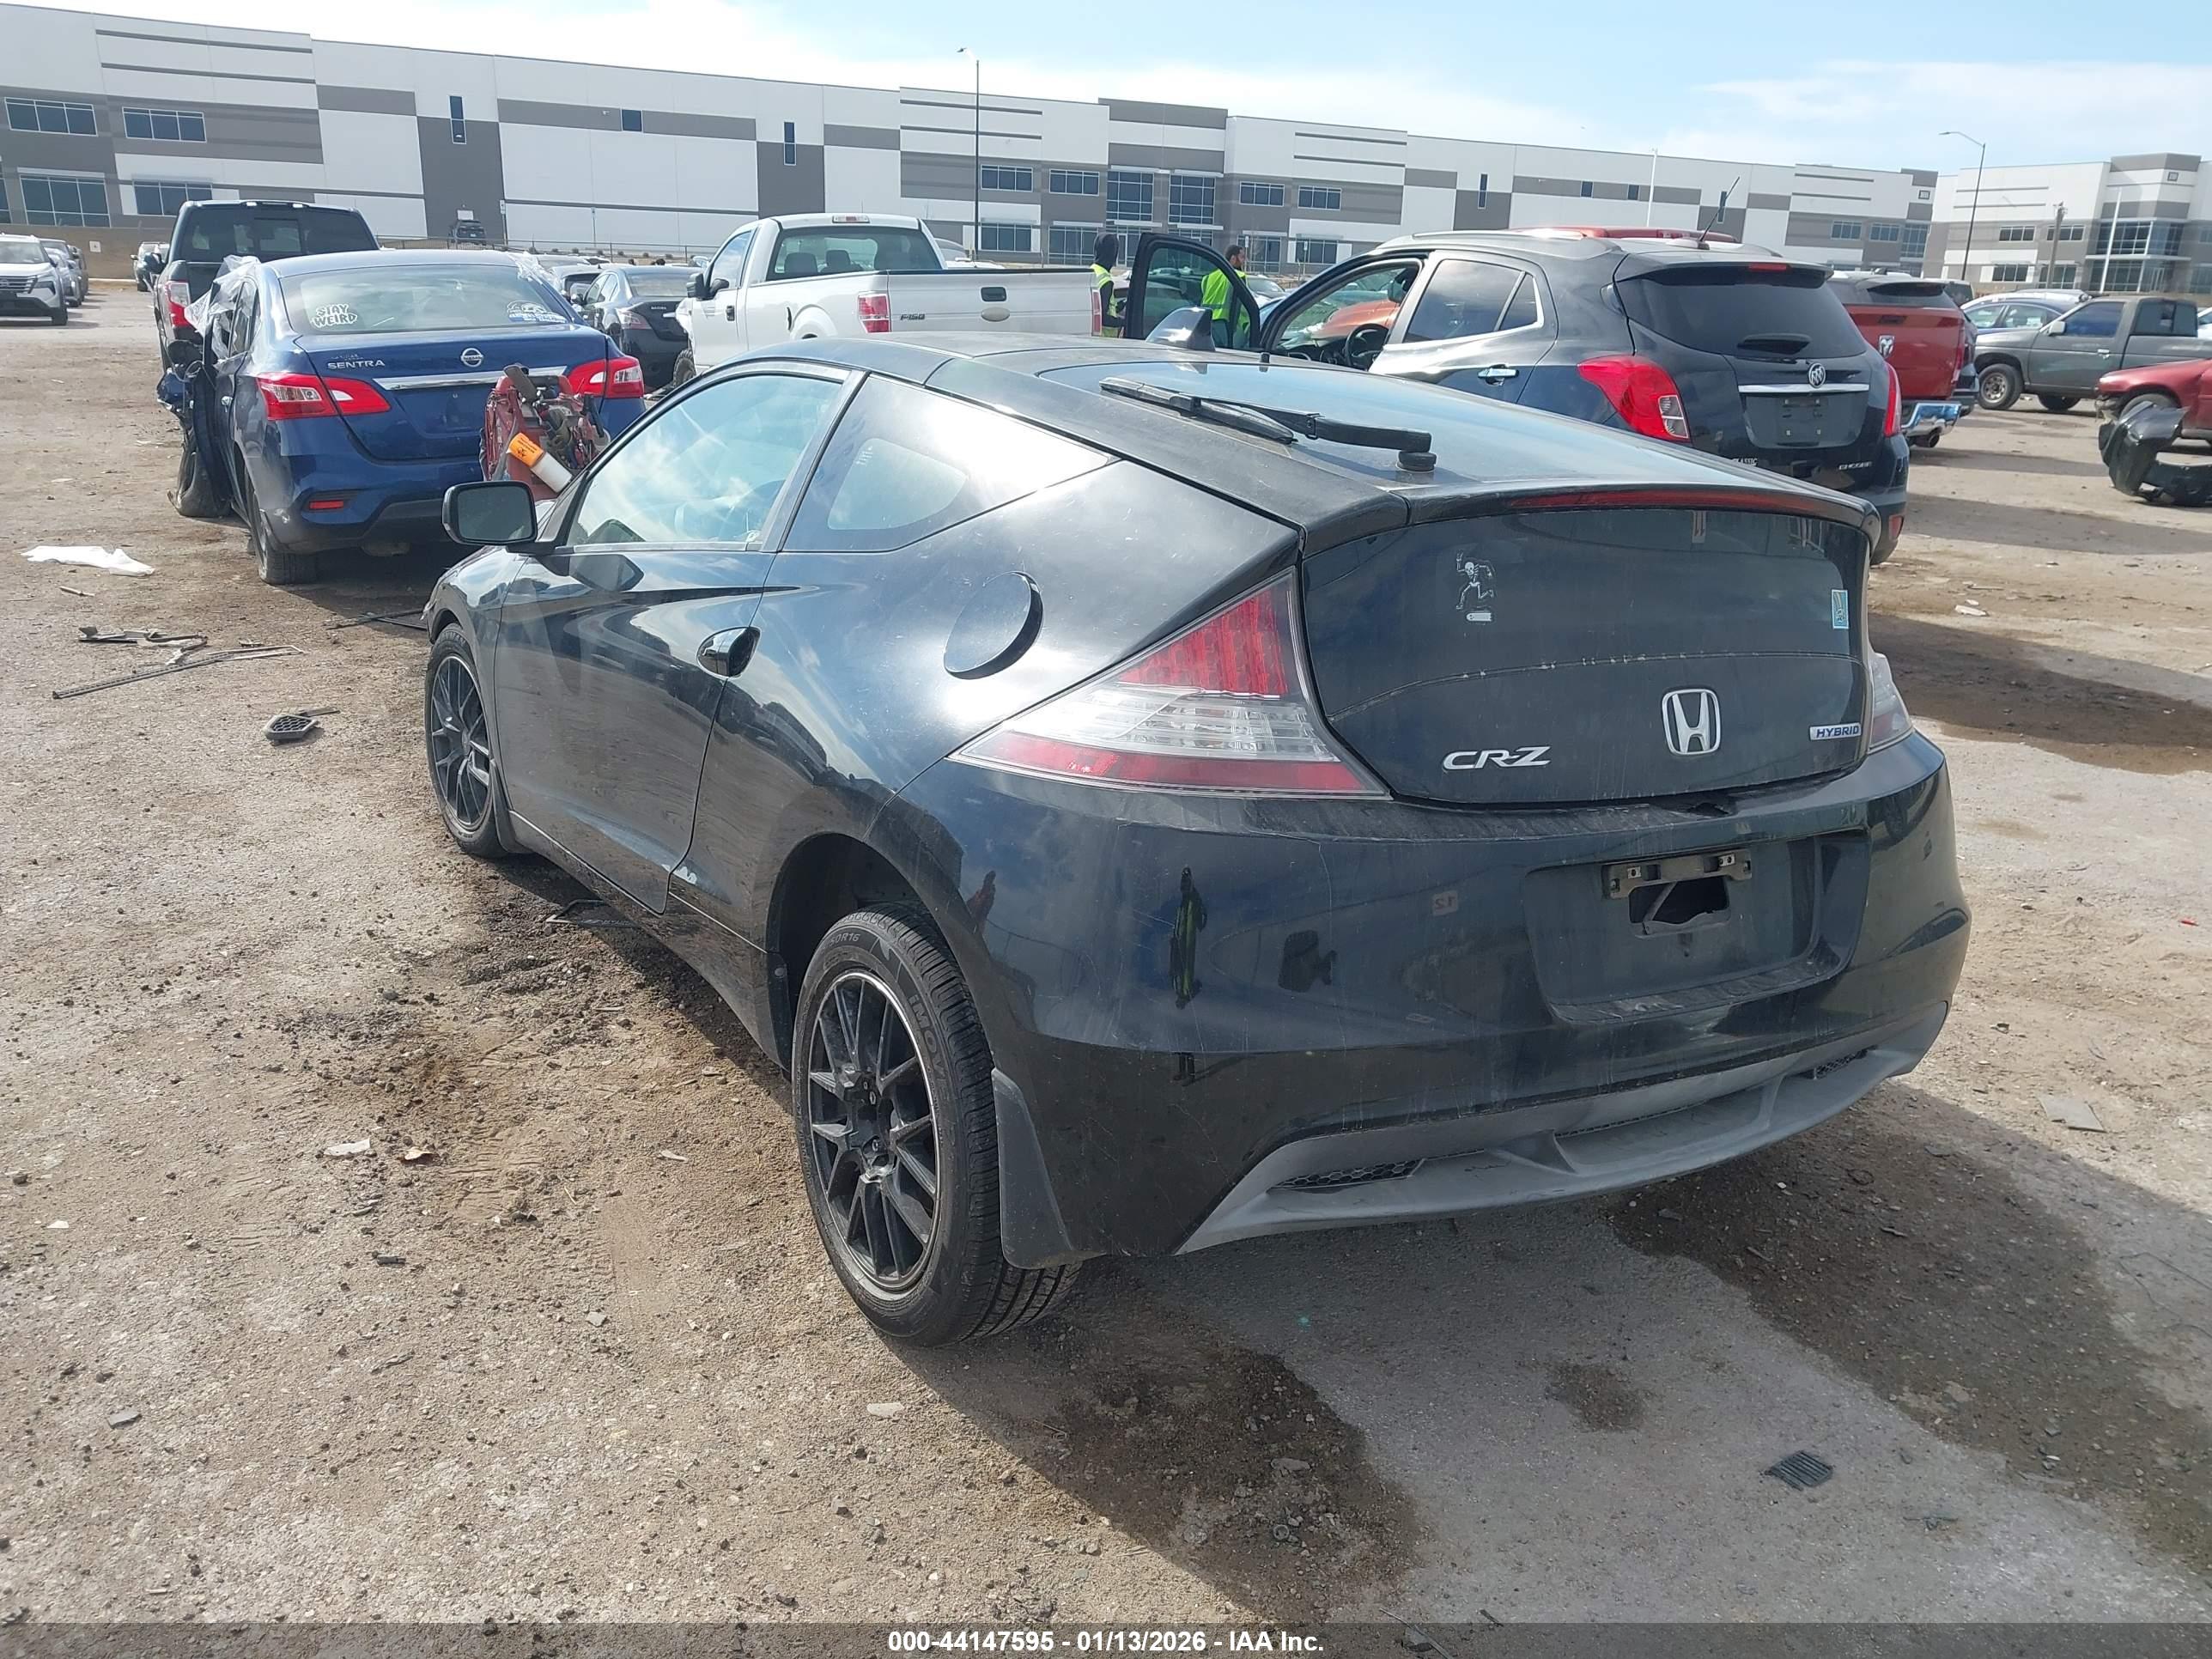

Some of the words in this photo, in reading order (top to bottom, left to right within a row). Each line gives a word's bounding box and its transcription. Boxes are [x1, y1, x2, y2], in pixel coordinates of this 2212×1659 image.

[311, 313, 357, 327] WEIRD
[327, 360, 386, 369] SENTRA
[1816, 726, 1859, 738] HYBRID
